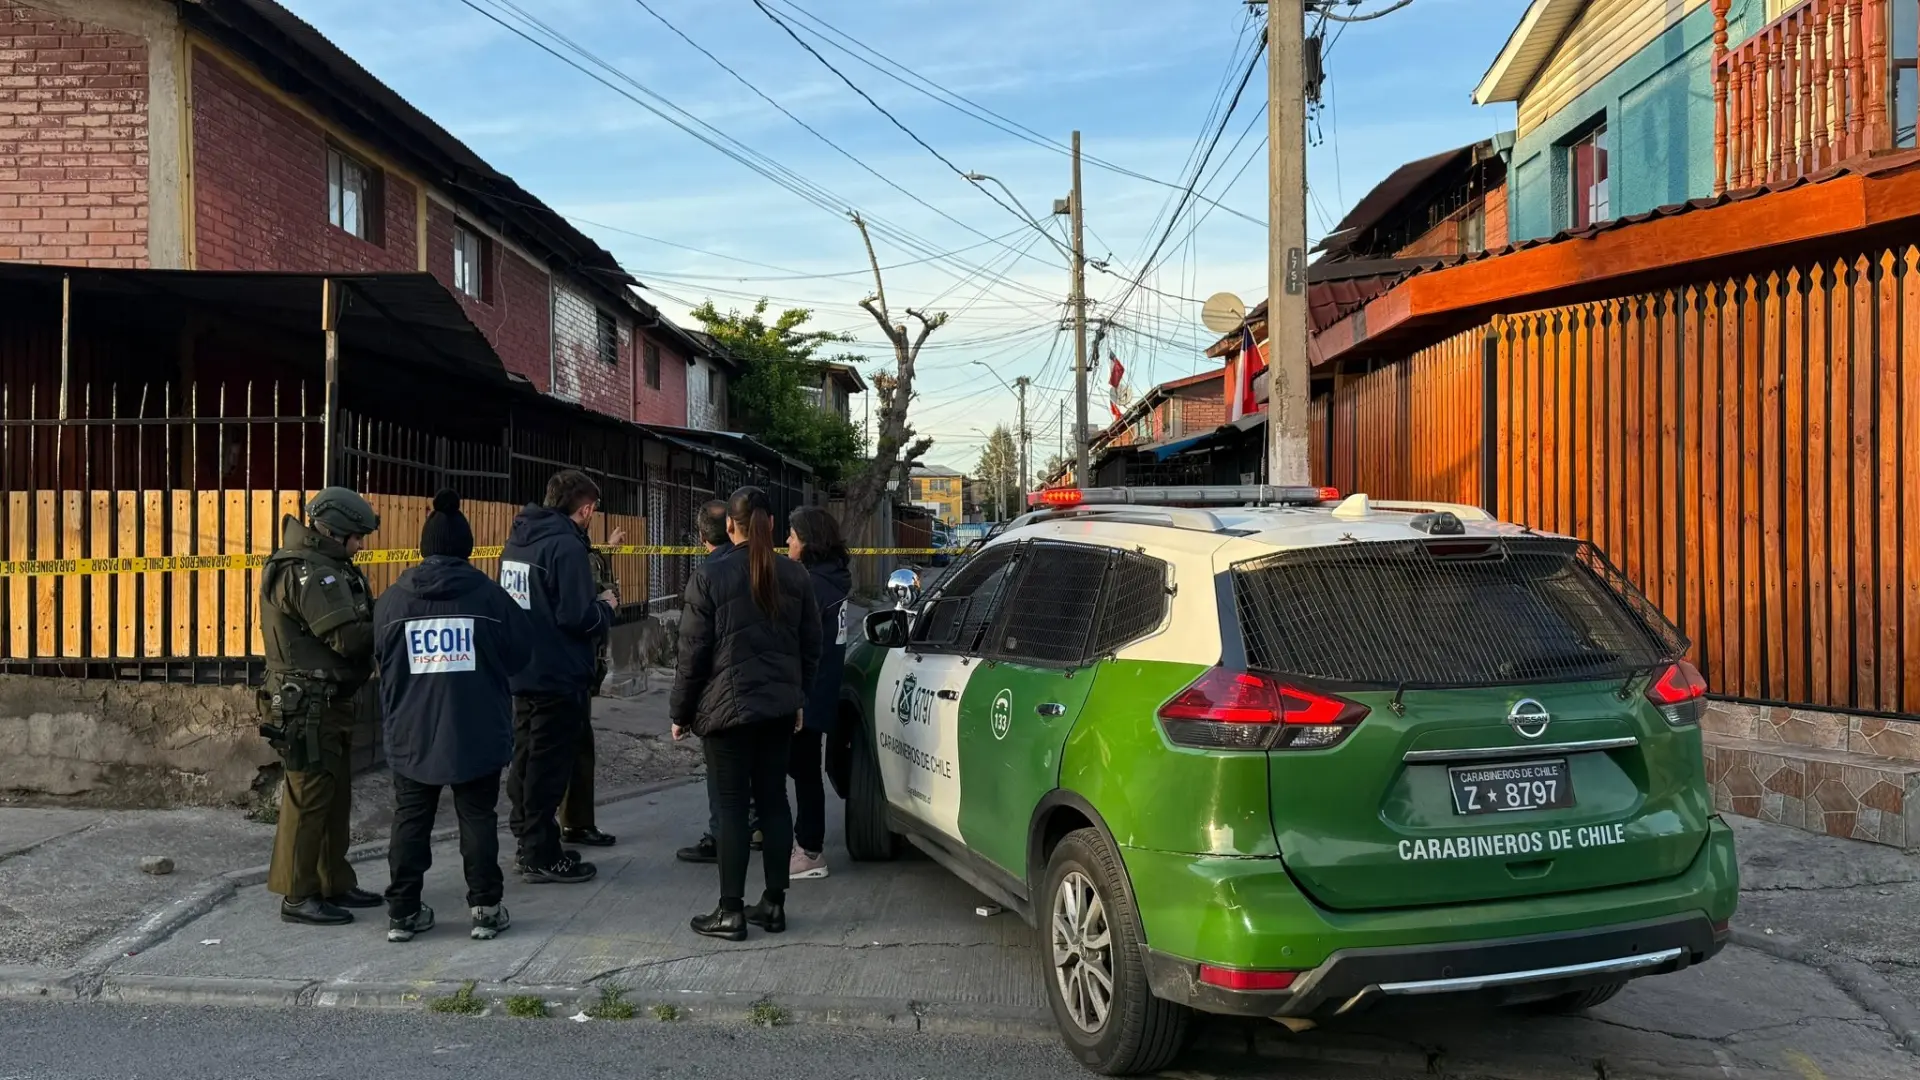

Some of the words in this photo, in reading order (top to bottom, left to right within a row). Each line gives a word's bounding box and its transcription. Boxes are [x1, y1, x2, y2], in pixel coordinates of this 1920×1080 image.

[180, 555, 231, 569] CARABINEROS
[246, 554, 268, 567] ASAR
[386, 550, 409, 561] PASAR
[5, 561, 15, 574] DE
[19, 560, 76, 573] CARABINEROS
[92, 559, 118, 571] PASAR
[122, 559, 132, 570] NO
[142, 557, 164, 570] CHILE
[167, 557, 176, 569] DE
[410, 628, 470, 654] ECOH
[413, 653, 470, 664] FISCALIA
[914, 687, 935, 726] 8797
[994, 713, 1007, 731] 133
[1514, 715, 1548, 725] NISSAN
[880, 732, 920, 766] CARABINEROS
[920, 752, 930, 771] DE
[930, 756, 952, 779] CHILE
[1460, 768, 1521, 783] CARABINEROS
[1521, 767, 1534, 778] DE
[1534, 765, 1559, 777] CHILE
[1464, 786, 1481, 810] Z
[1505, 780, 1557, 807] 8797
[1398, 831, 1543, 861] CARABINEROS
[1549, 829, 1573, 850] DE
[1577, 823, 1625, 847] CHILE
